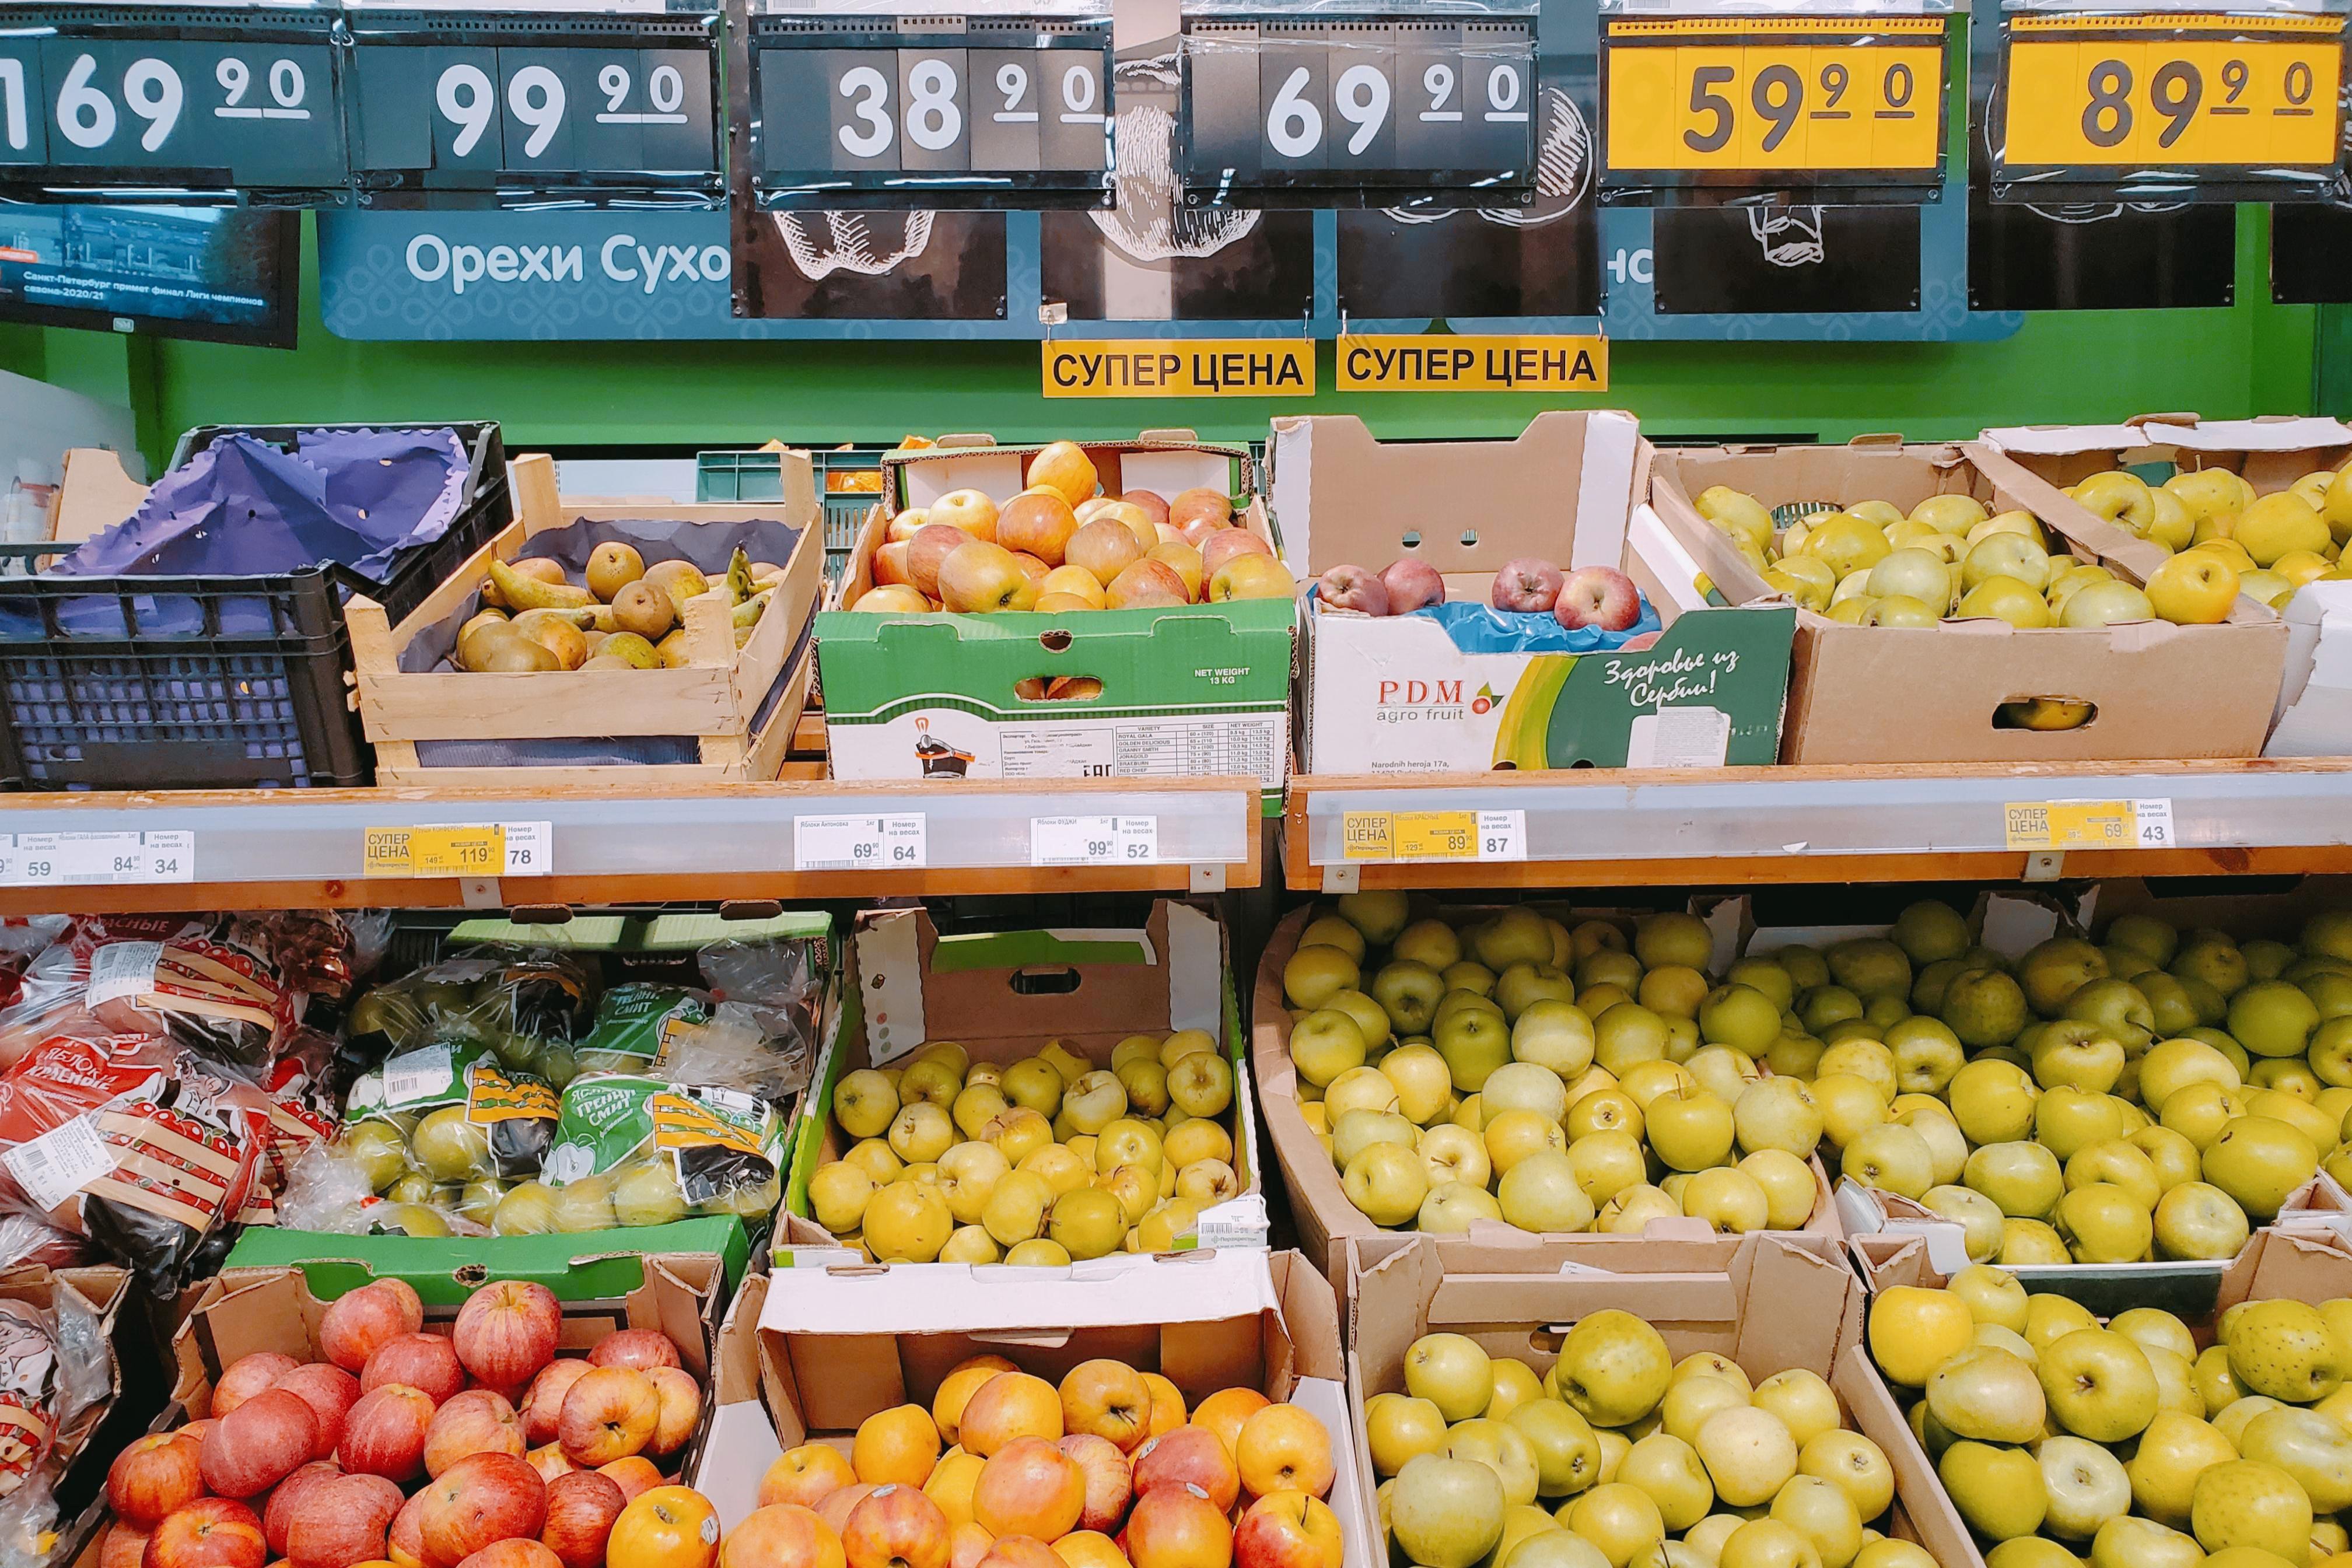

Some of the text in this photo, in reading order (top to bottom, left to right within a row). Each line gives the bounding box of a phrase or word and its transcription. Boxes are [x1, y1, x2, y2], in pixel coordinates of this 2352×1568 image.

[0, 52, 310, 152] 169 90
[838, 58, 963, 158] 38
[1682, 64, 1804, 153] 59
[2081, 59, 2203, 148] 89
[436, 64, 688, 158] 99 90
[1267, 64, 1391, 158] 69
[405, 233, 583, 295] Орехи
[23, 271, 263, 306] Санкт-Петербург примет финал Лиги чемпионов
[1053, 354, 1303, 392] СУПЕР ЦЕНА
[1348, 348, 1597, 388] СУПЕР ЦЕНА
[1194, 667, 1250, 677] NET WEIGHT
[1604, 648, 1740, 690] Здоровье из
[1222, 676, 1235, 684] KG
[1377, 680, 1465, 705] PDM
[1630, 670, 1717, 710] Сербии!
[1377, 709, 1464, 723] agro fruit
[1371, 760, 1405, 768] Narodnih
[1407, 760, 1431, 769] heroja
[2009, 808, 2048, 819] СУПЕР
[1348, 817, 1387, 828] СУПЕР
[2010, 820, 2049, 834] ЦЕНА
[1347, 829, 1388, 843] ЦЕНА
[2105, 824, 2122, 838] 69
[2142, 826, 2164, 841] 43
[368, 833, 410, 845] СУПЕР
[1448, 835, 1465, 850] 89
[1487, 838, 1508, 852] 87
[368, 845, 410, 859] ЦЕНА
[460, 848, 488, 863] 119
[853, 843, 872, 858] 69
[893, 846, 916, 860] 64
[1088, 841, 1106, 855] 99
[1127, 844, 1149, 858] 52
[113, 856, 133, 872] 84
[509, 849, 531, 865] 78
[28, 861, 51, 876] 59
[155, 858, 178, 874] 34
[44, 1047, 119, 1083] ЯБЛОКИ
[589, 1097, 629, 1126] СМИТ
